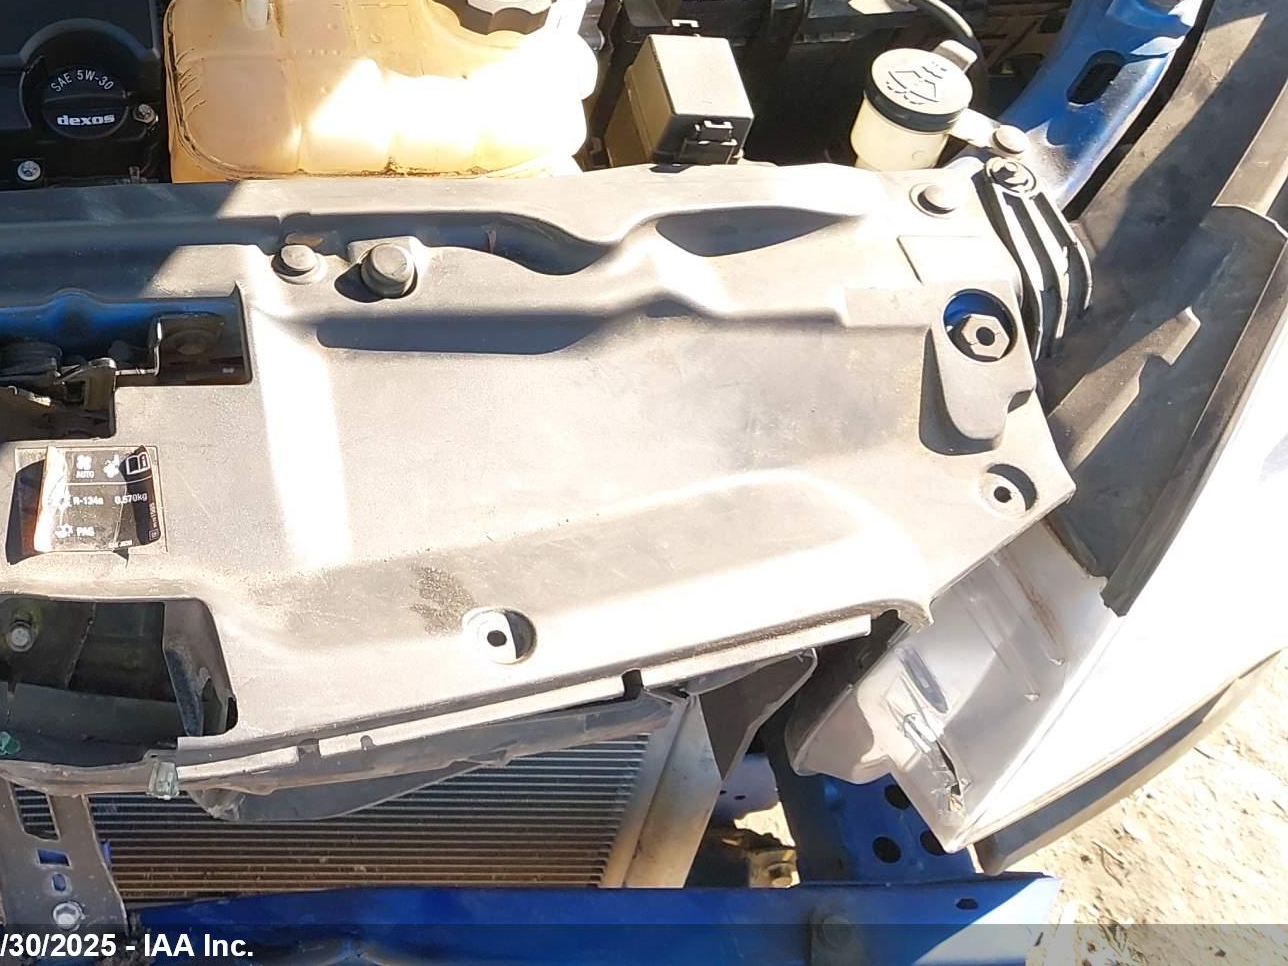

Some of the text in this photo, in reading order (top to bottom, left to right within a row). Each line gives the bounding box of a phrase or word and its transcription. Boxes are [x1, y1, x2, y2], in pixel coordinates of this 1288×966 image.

[50, 69, 114, 92] SAE 5W-30
[56, 114, 116, 126] dexos
[73, 496, 104, 505] R-134a
